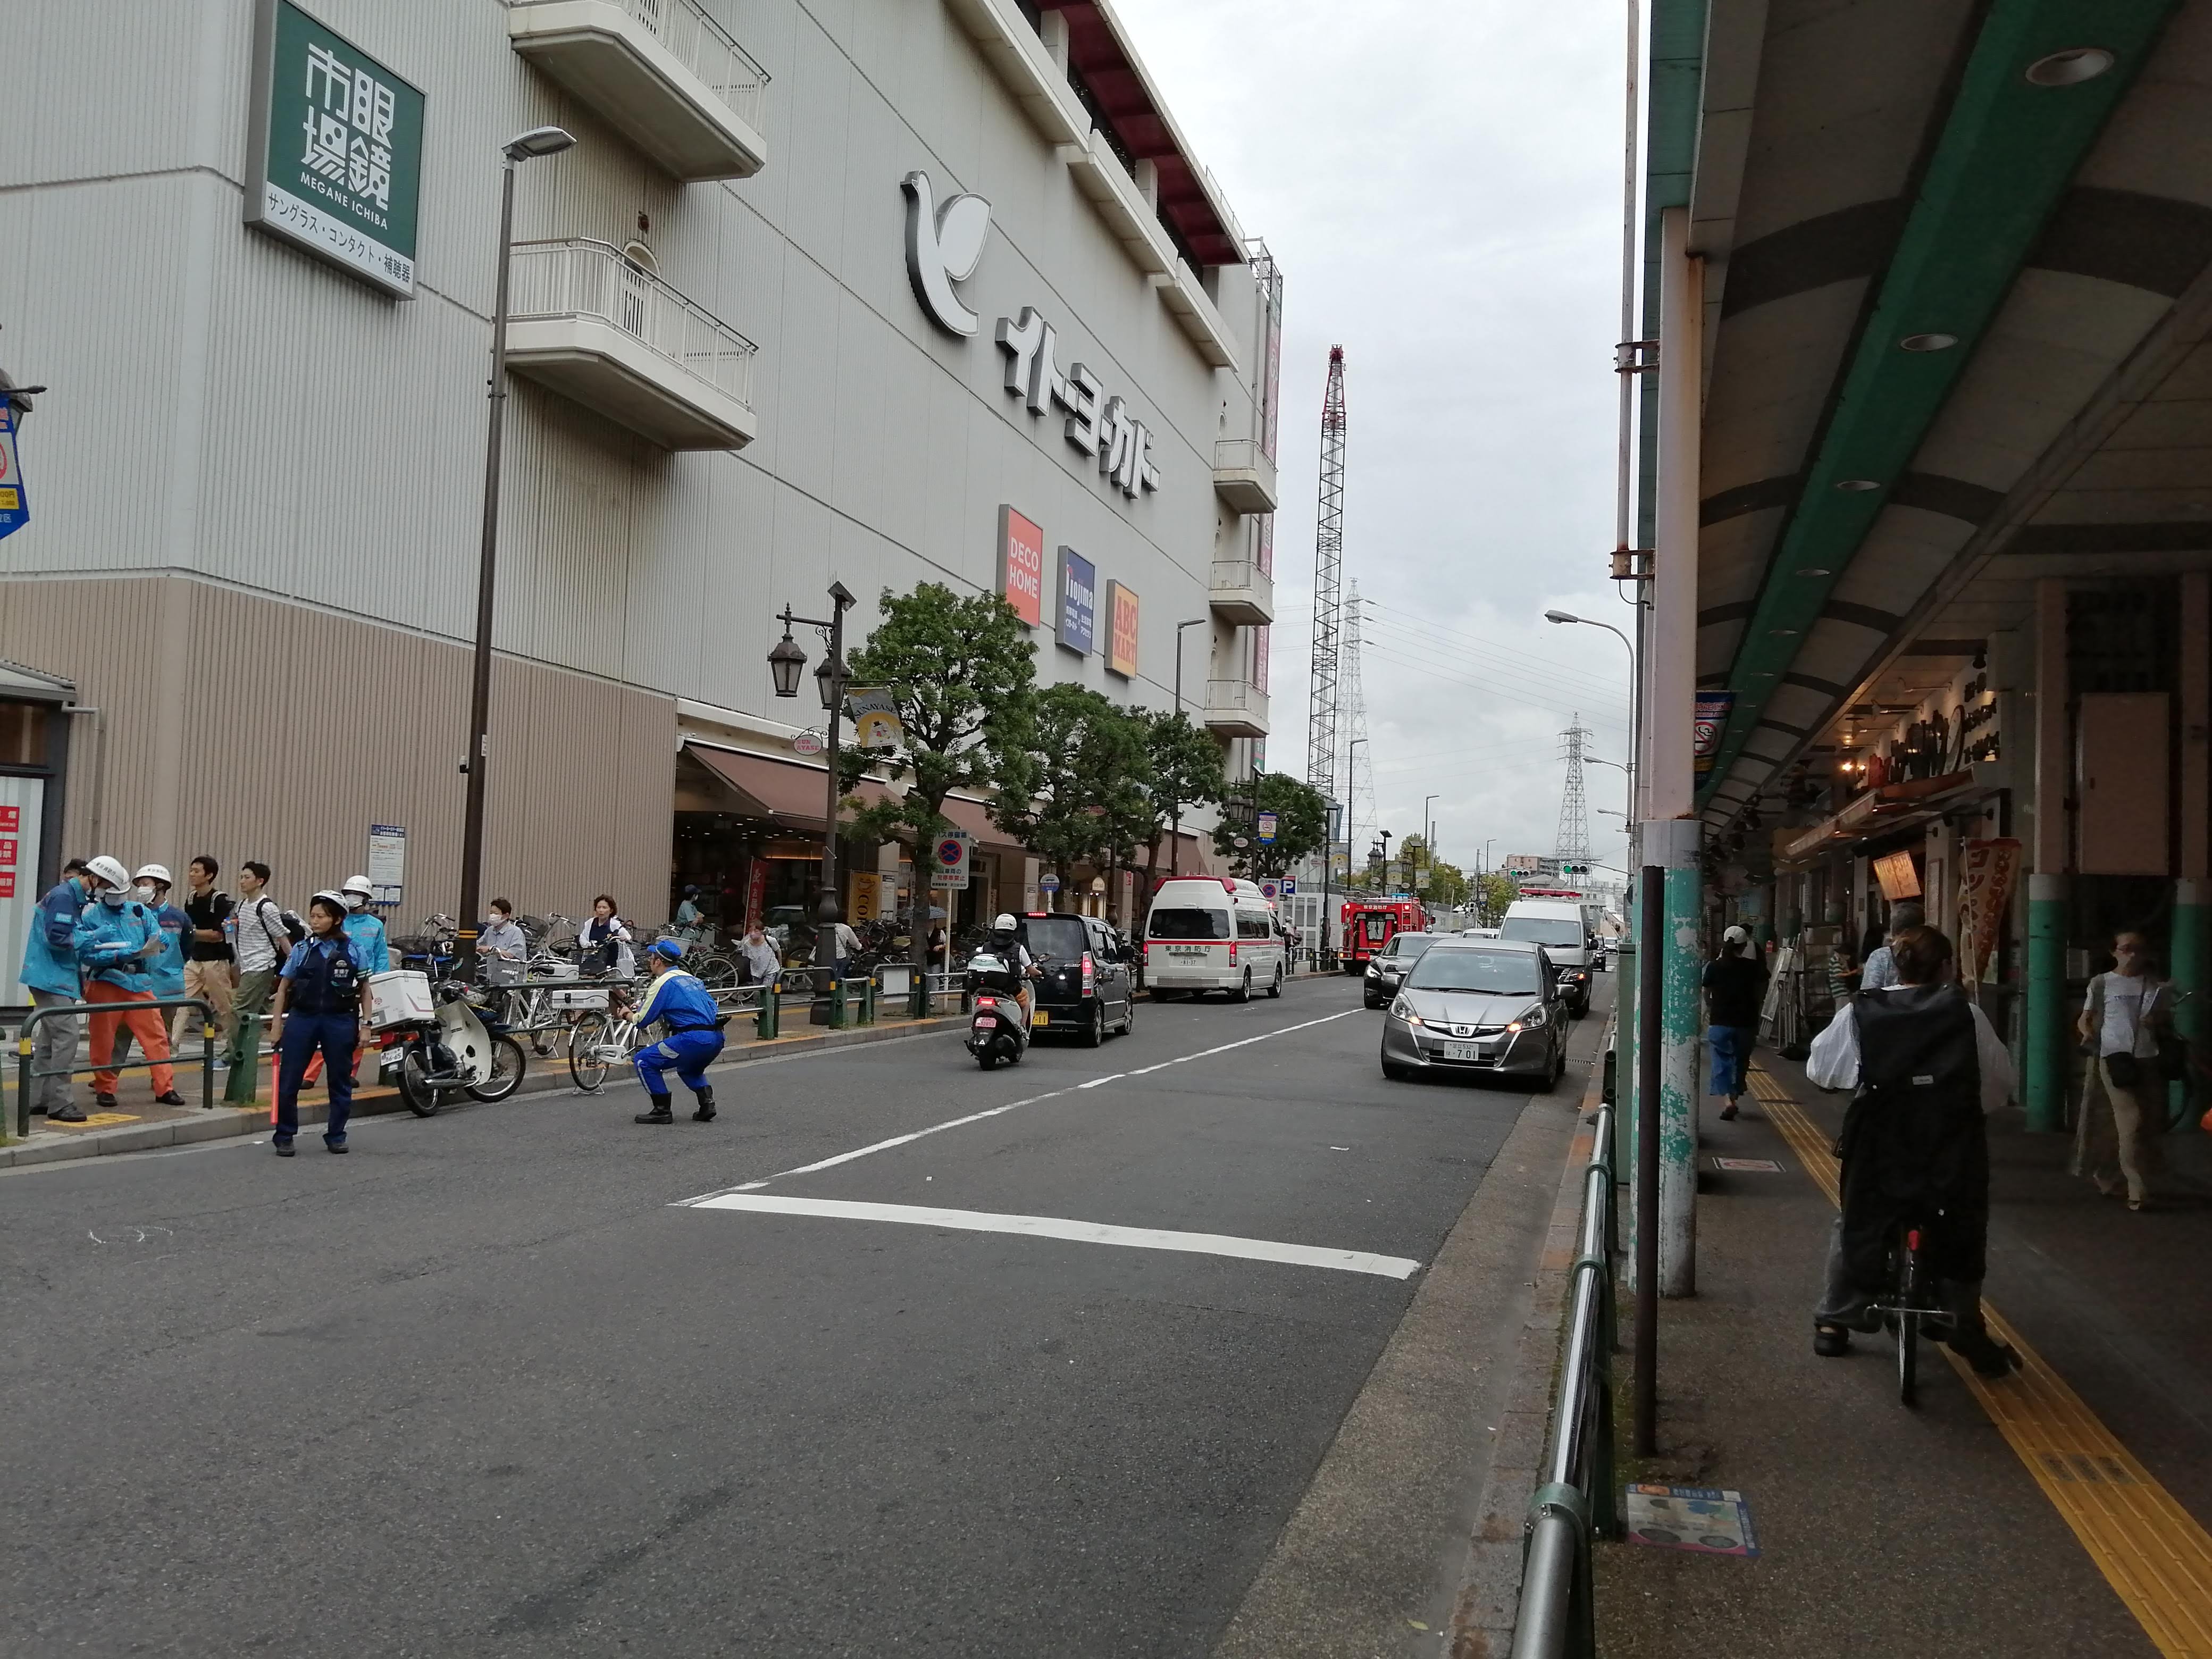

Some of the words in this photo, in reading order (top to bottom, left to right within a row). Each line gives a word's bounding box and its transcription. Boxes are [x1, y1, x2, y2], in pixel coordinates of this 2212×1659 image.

[300, 172, 348, 208] MEGANE
[351, 195, 388, 230] ICHIBA
[1011, 537, 1038, 572] DECO
[1010, 564, 1038, 599] HOME
[1115, 596, 1136, 640] ABC
[1113, 632, 1135, 666] MART
[854, 703, 896, 718] SUNAYASE
